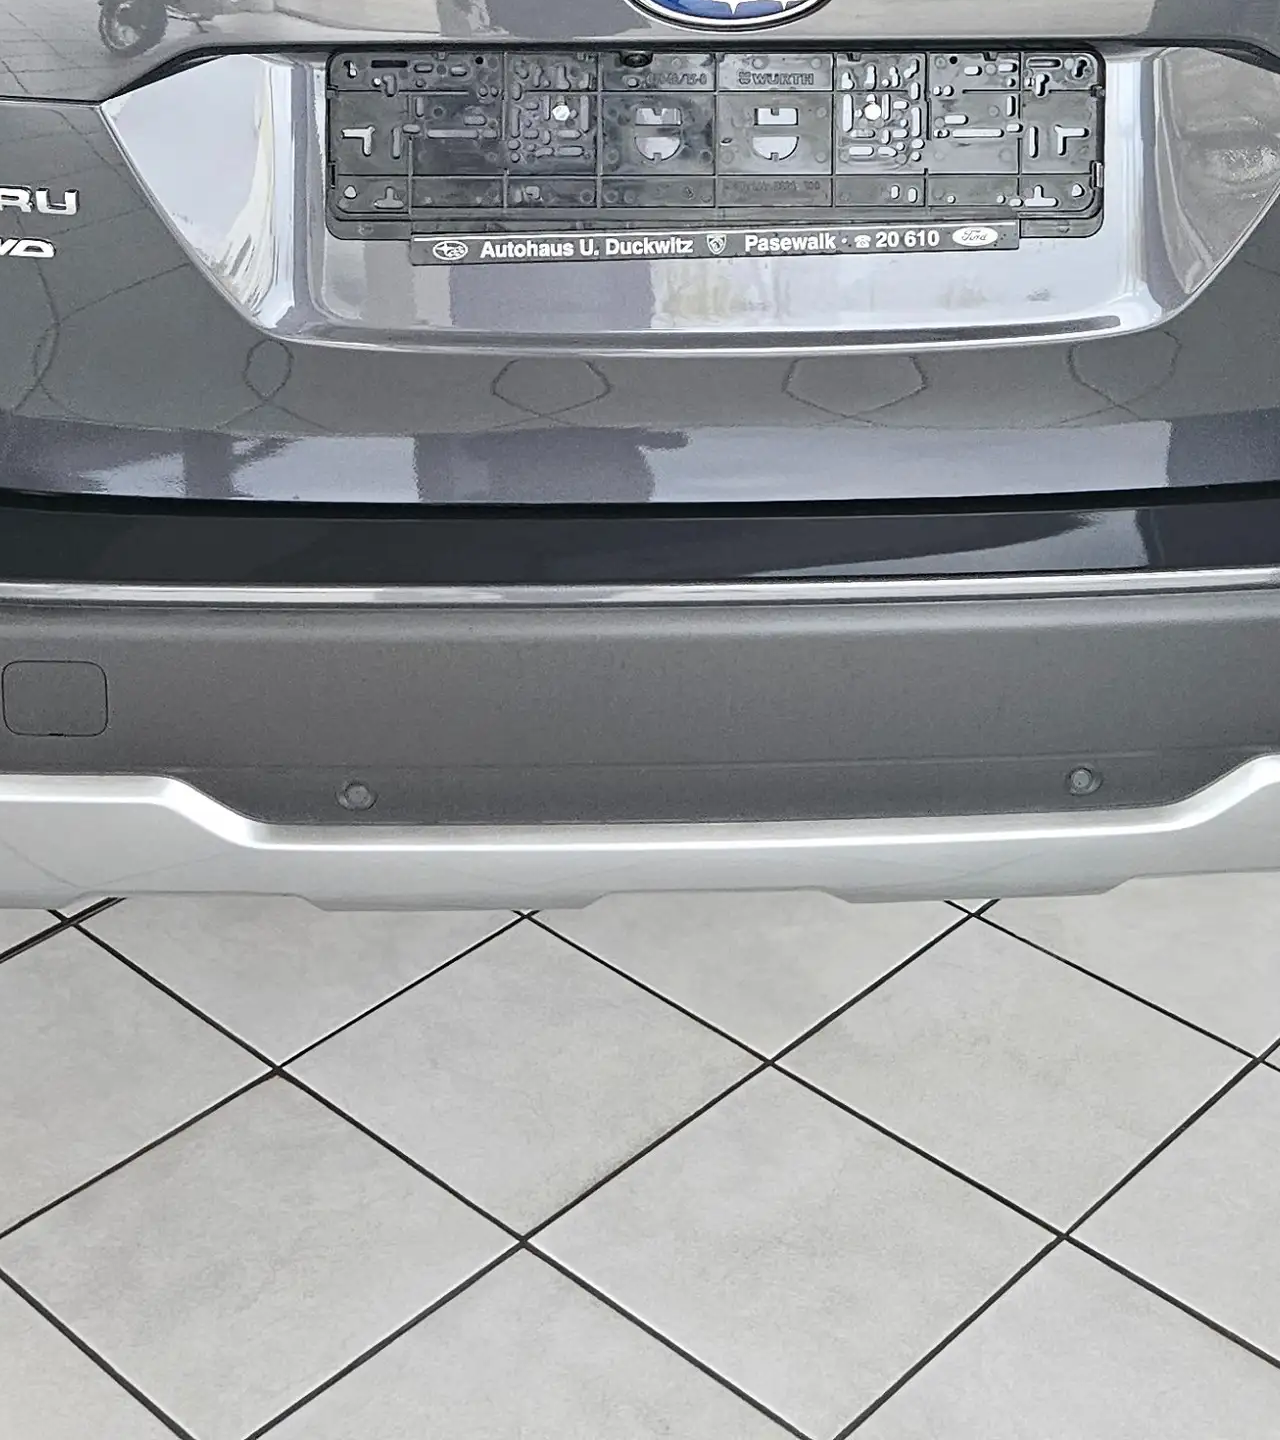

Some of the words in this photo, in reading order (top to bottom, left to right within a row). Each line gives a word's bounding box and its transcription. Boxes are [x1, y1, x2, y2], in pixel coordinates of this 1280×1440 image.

[480, 240, 574, 259] Autohaus
[579, 238, 600, 256] U.
[605, 235, 694, 255] Duckwitz
[744, 232, 836, 253] Pasewalk
[875, 231, 901, 248] 20
[904, 229, 941, 247] 610
